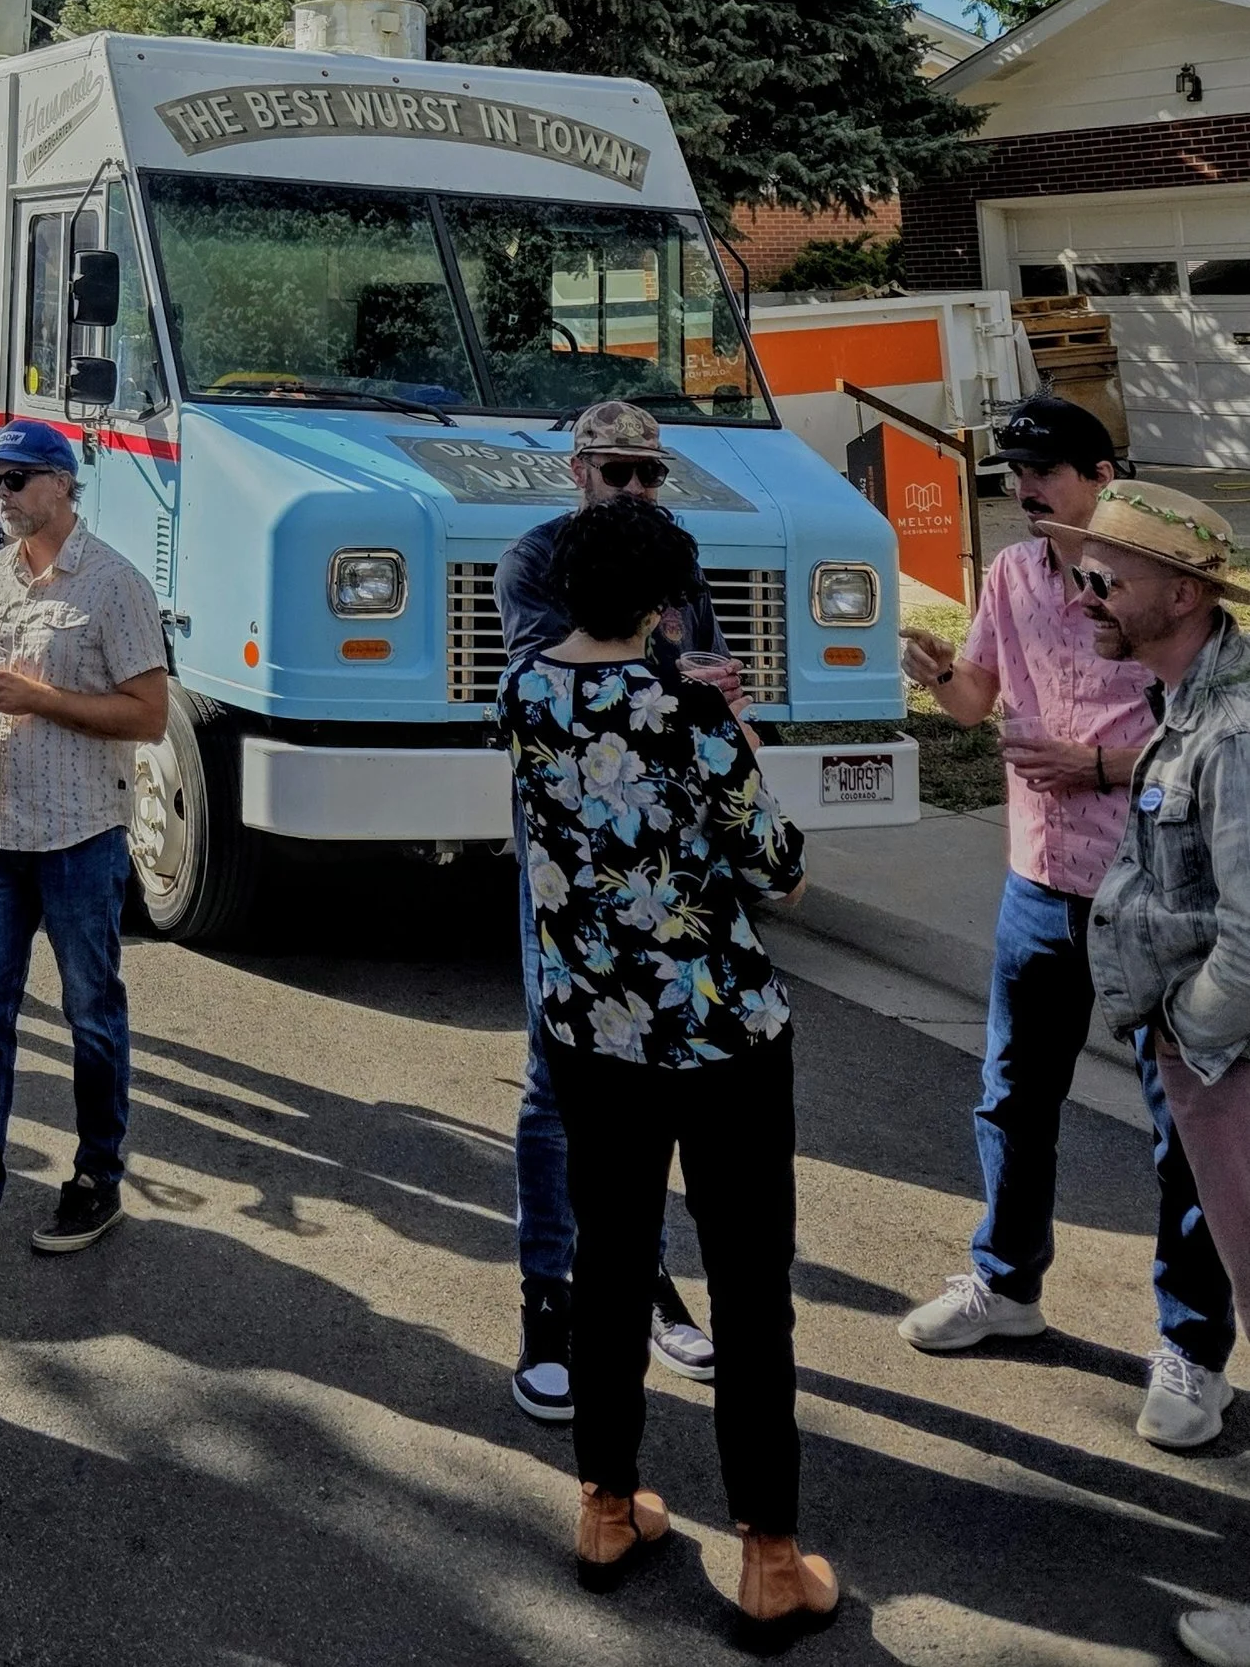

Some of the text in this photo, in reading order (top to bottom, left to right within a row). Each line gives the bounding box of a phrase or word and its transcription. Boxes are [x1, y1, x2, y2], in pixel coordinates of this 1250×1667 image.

[166, 90, 635, 179] THE BEST WURST IN TOWN
[433, 443, 502, 461] DAS
[898, 515, 952, 527] MELTON
[839, 766, 883, 791] WURST
[841, 792, 877, 801] COLORADO
